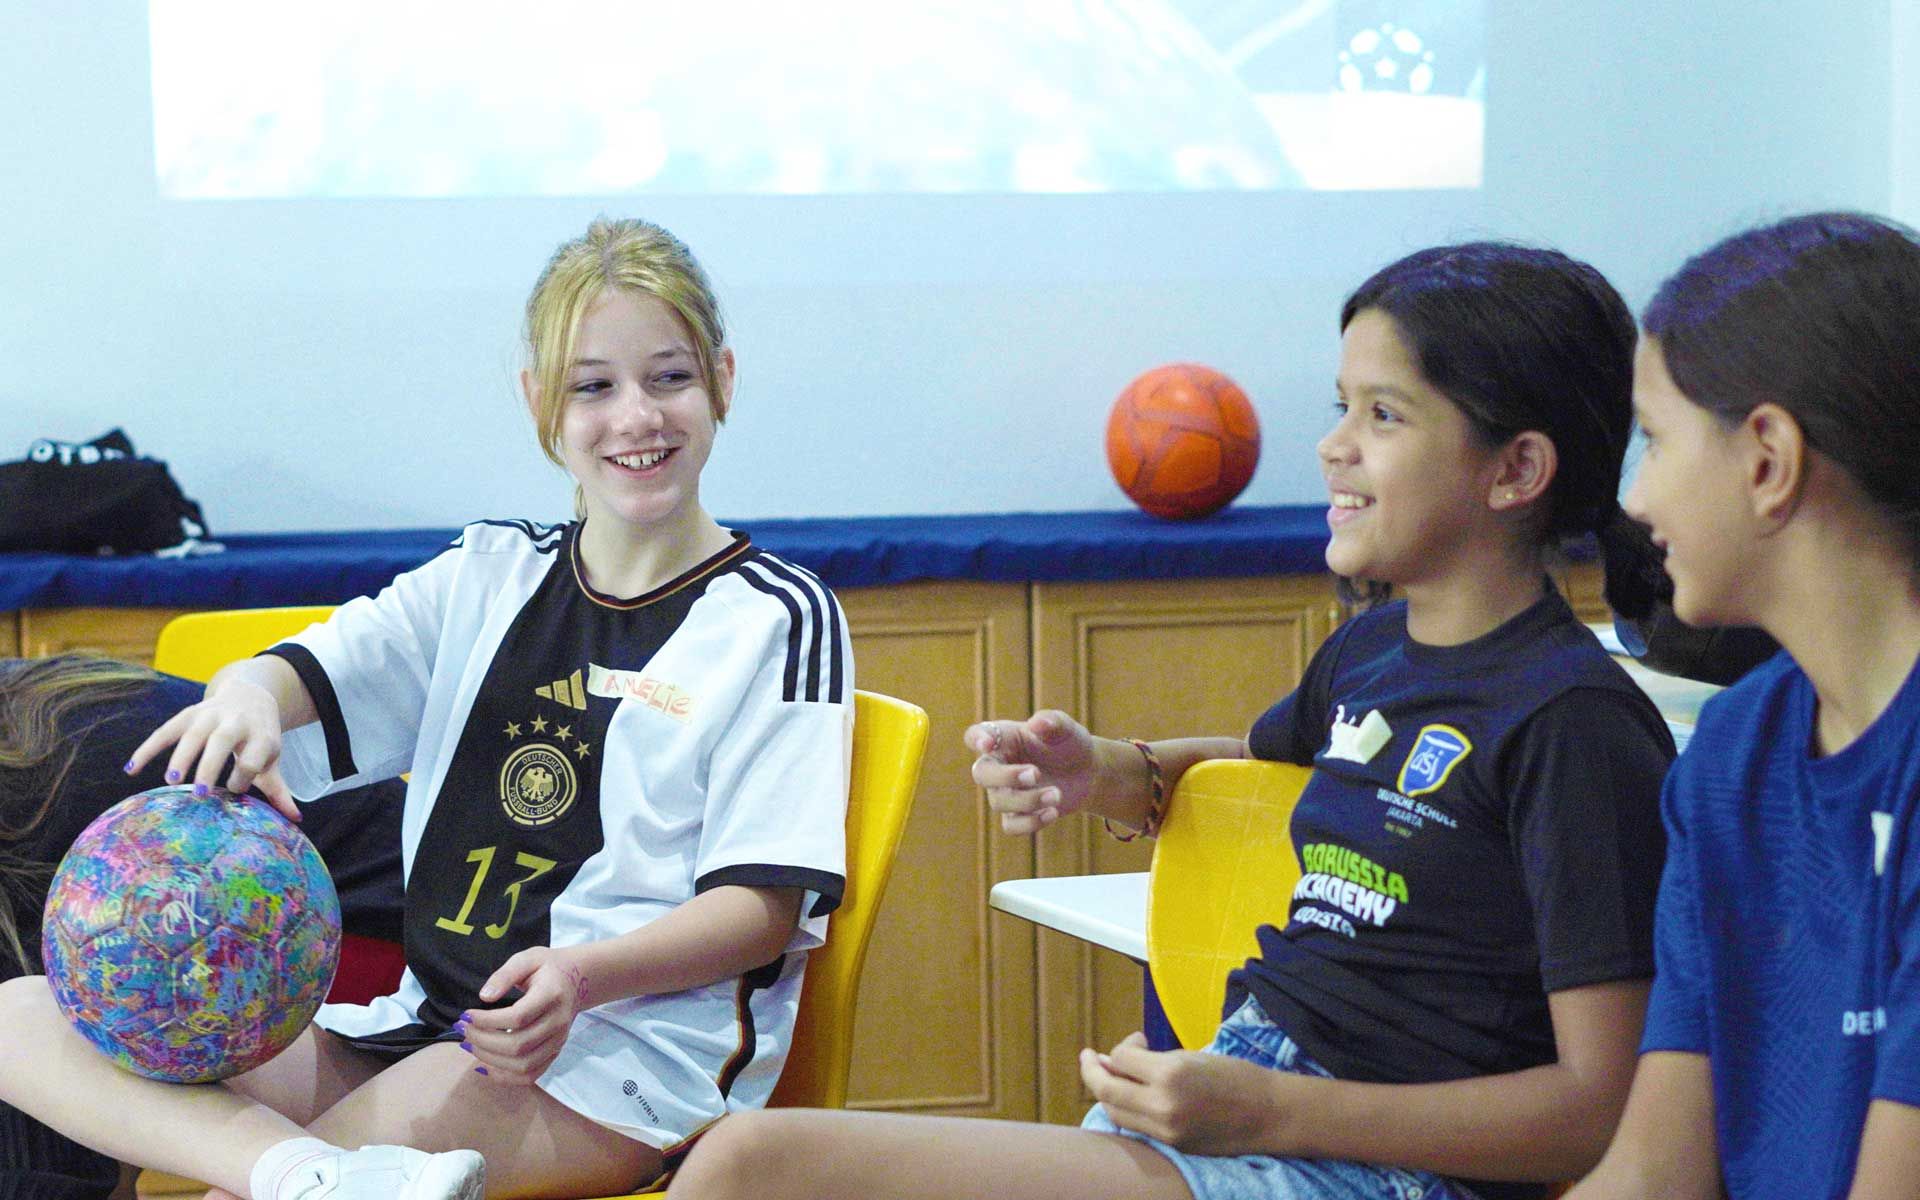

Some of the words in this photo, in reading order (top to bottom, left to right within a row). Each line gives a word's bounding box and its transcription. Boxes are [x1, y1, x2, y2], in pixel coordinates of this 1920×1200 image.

[521, 753, 563, 775] DEUTSCHER
[1414, 801, 1457, 828] SCHULE
[435, 846, 557, 939] 13
[1293, 872, 1396, 927] ACADEMY
[1302, 843, 1409, 904] BORUSSIA
